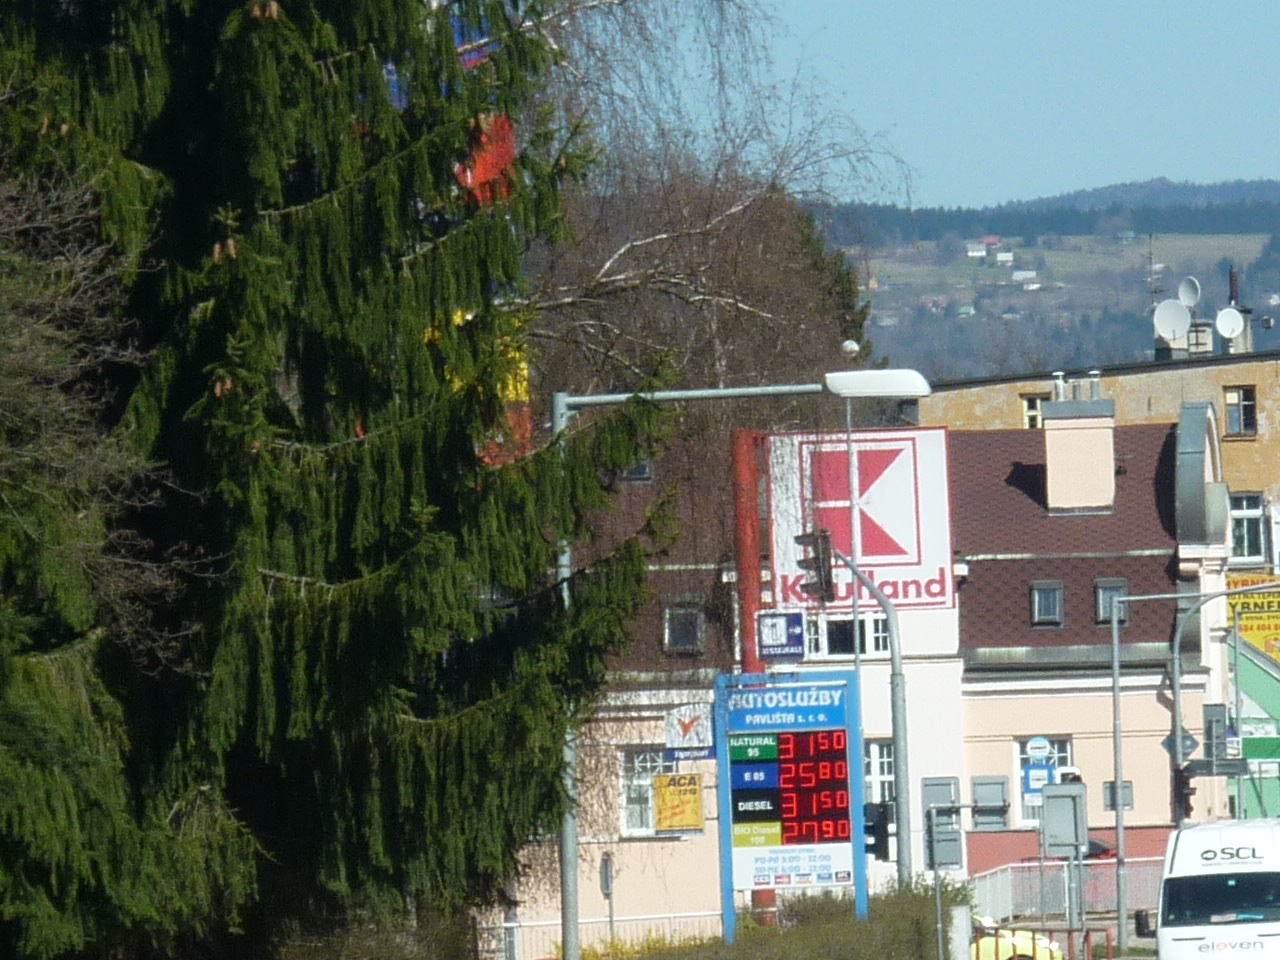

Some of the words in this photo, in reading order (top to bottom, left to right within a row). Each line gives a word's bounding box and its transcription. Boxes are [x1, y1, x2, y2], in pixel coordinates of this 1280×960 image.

[780, 567, 947, 604] Kufland
[729, 688, 843, 711] AUTOSLUŽBY
[730, 739, 777, 747] NATURAL
[738, 802, 773, 811] DIESEL
[1220, 847, 1264, 860] SCL
[1197, 940, 1265, 953] eleven
